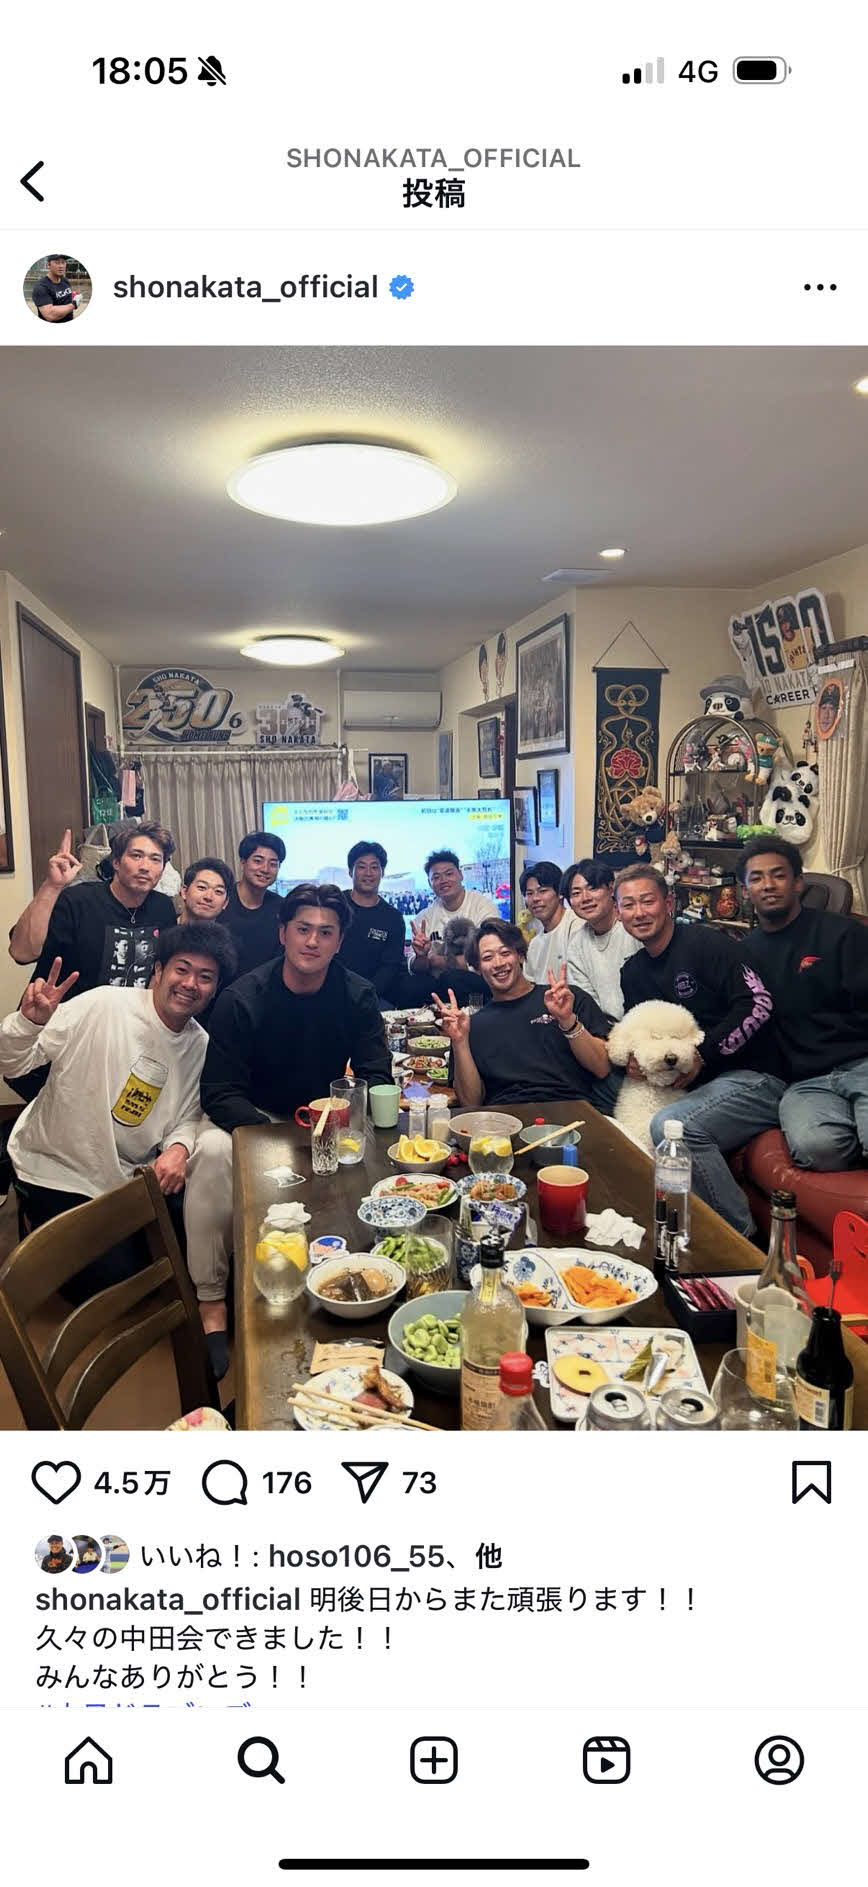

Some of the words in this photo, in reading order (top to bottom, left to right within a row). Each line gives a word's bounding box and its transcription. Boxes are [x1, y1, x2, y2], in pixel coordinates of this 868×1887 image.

[766, 689, 810, 705] CAREER
[260, 735, 278, 745] SHO
[281, 735, 316, 745] NAKATA
